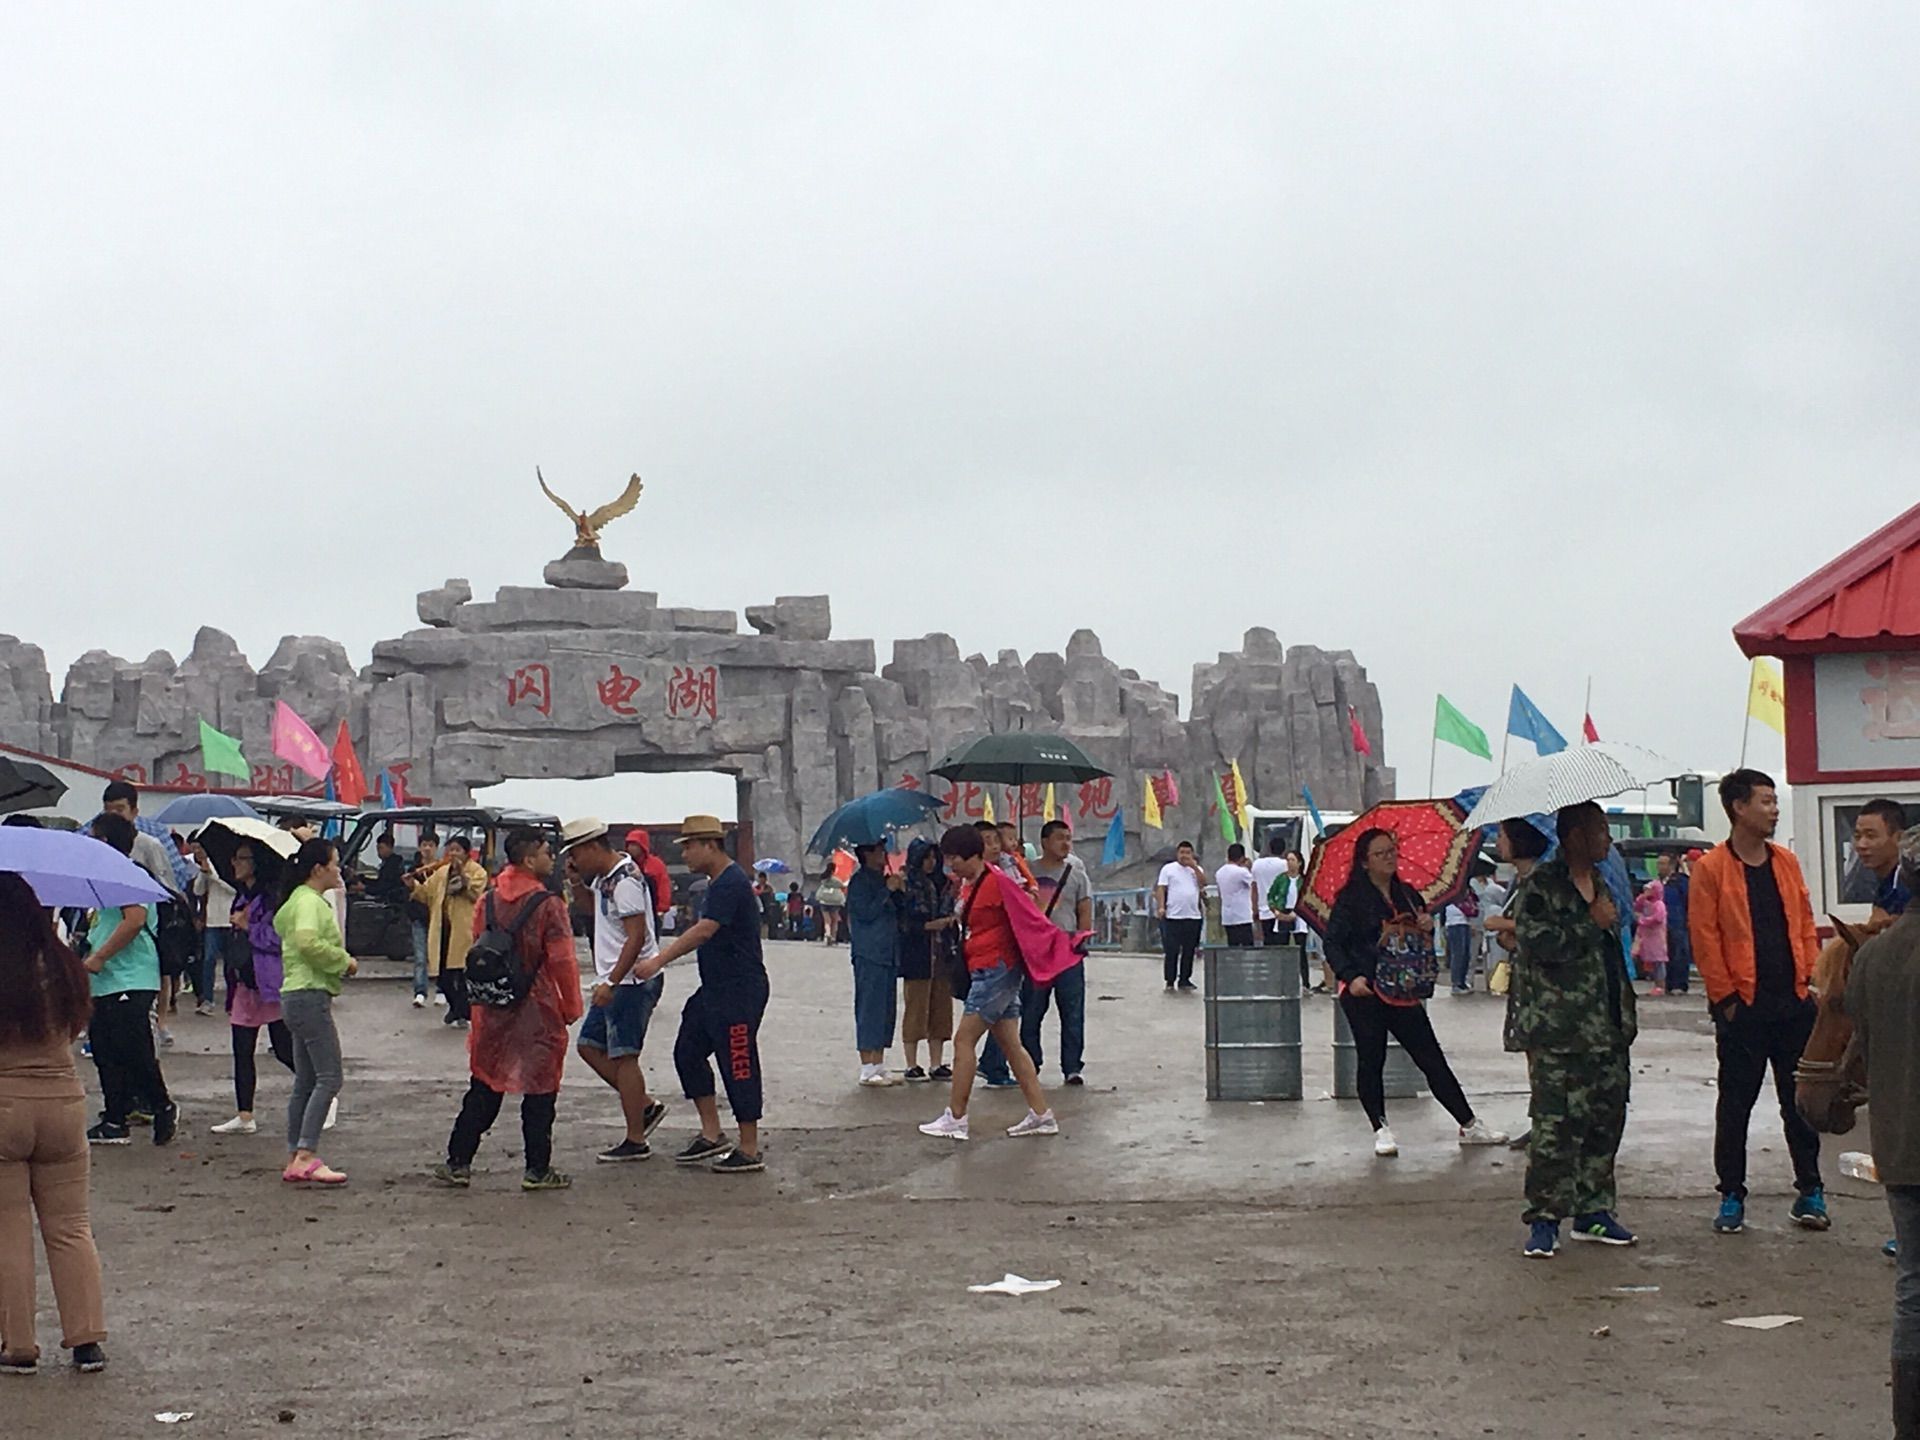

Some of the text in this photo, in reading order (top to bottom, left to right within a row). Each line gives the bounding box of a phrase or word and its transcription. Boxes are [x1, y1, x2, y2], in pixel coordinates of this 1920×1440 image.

[507, 663, 717, 720] 闪电湖
[730, 1023, 751, 1080] BOXER
